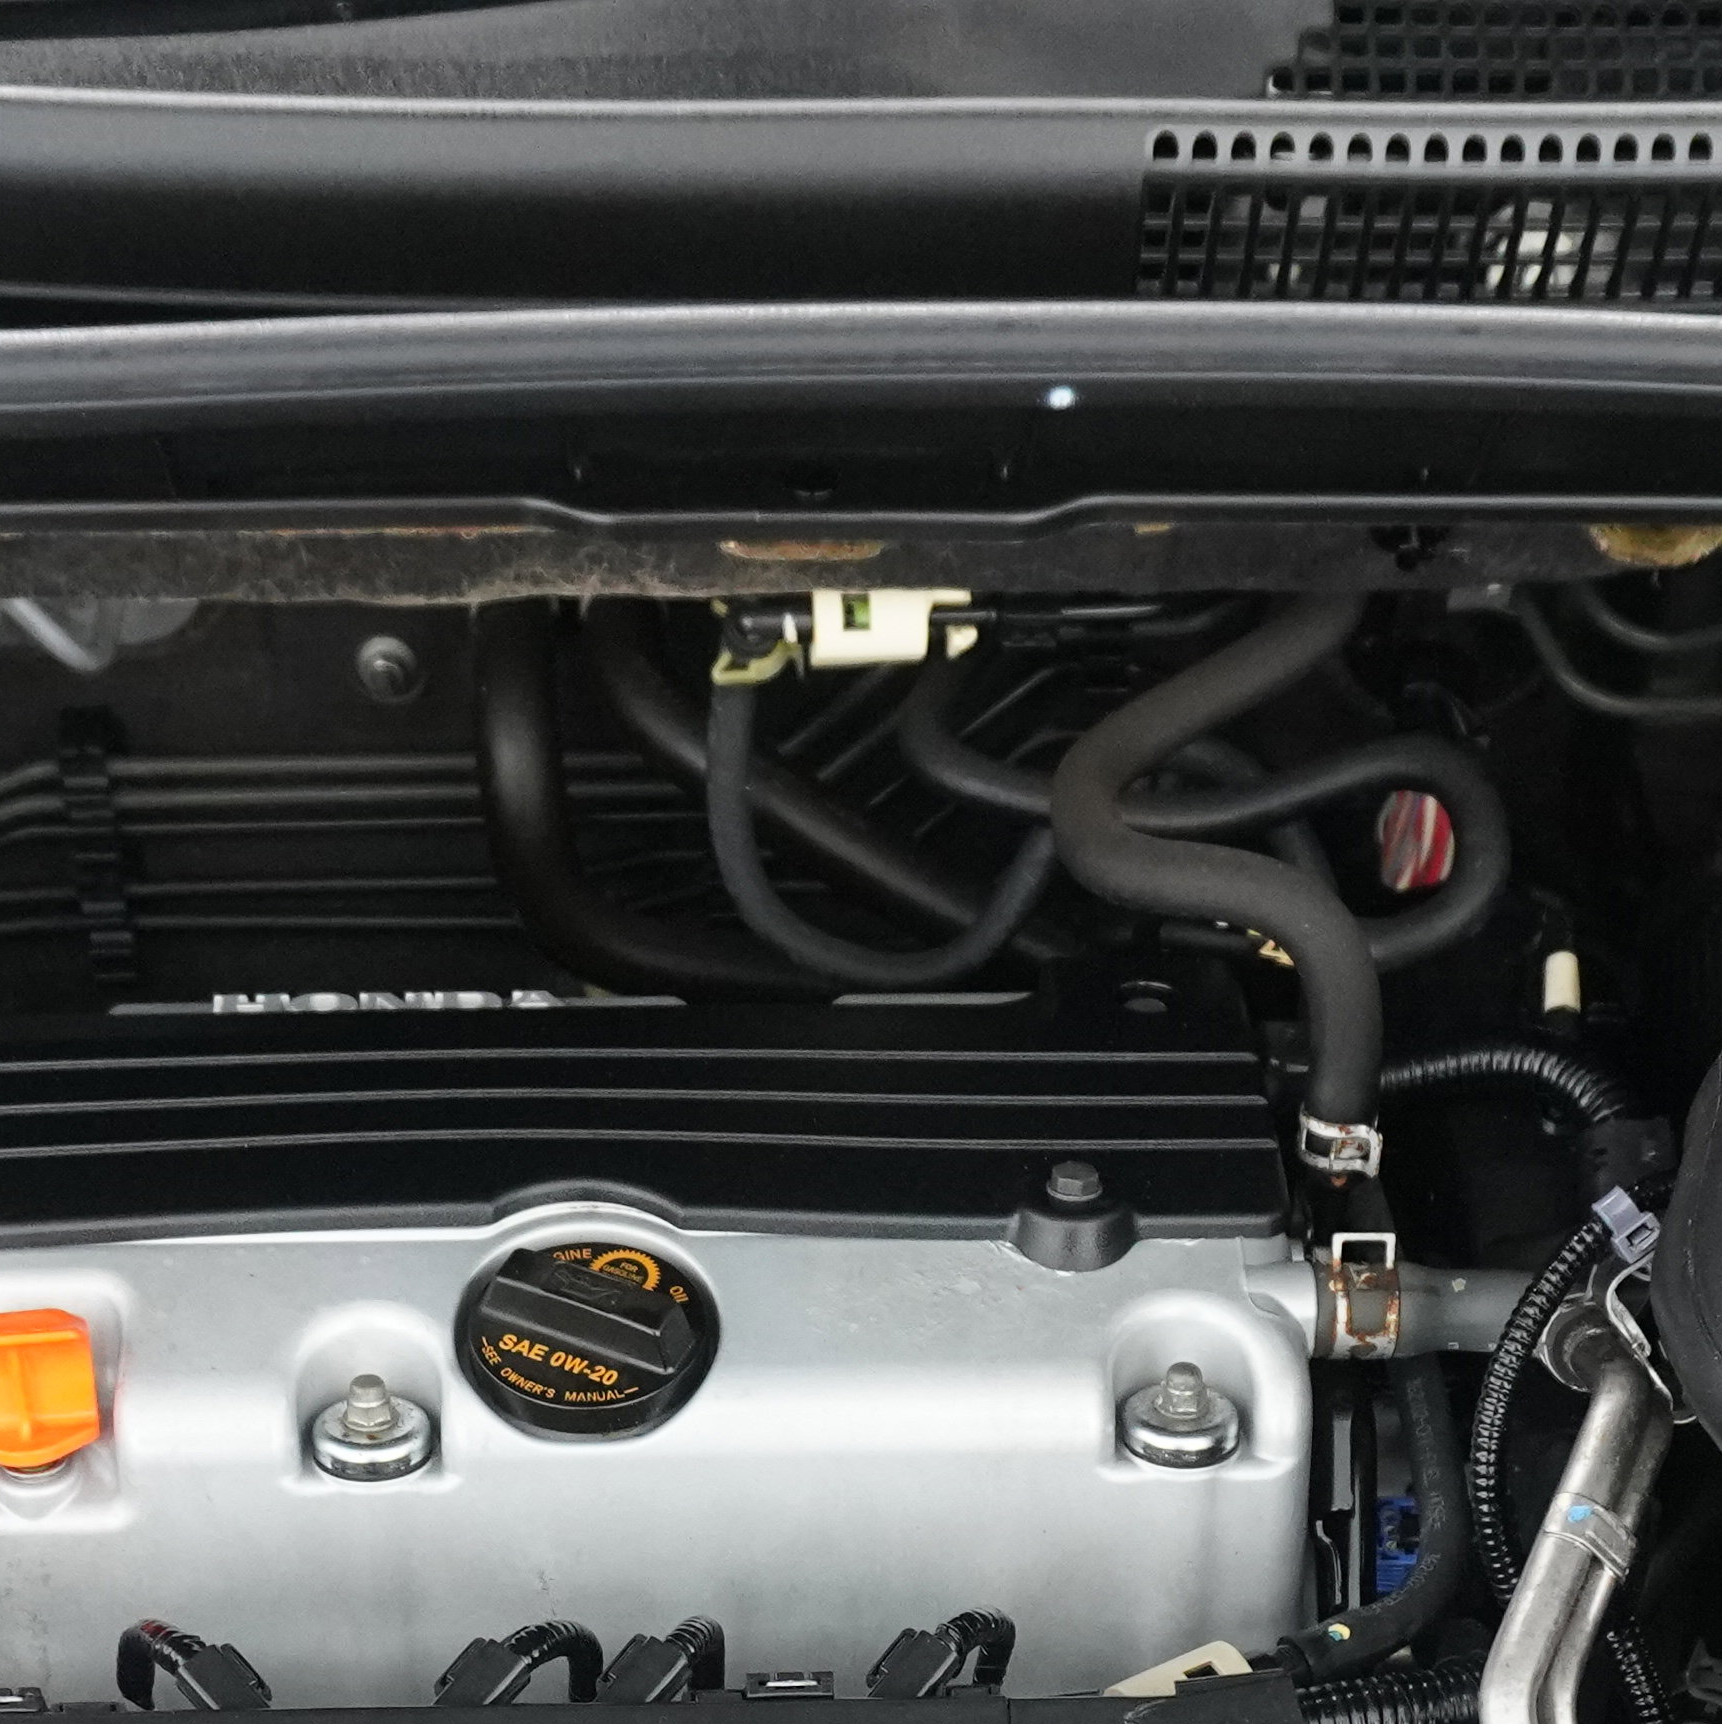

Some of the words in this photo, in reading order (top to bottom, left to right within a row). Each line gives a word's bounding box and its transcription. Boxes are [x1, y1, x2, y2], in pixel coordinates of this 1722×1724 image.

[619, 1261, 639, 1273] FOR
[481, 1344, 503, 1366] SEE
[499, 1366, 556, 1399] OWNER'S
[497, 1333, 550, 1362] SAE
[550, 1350, 619, 1387] 0W-20
